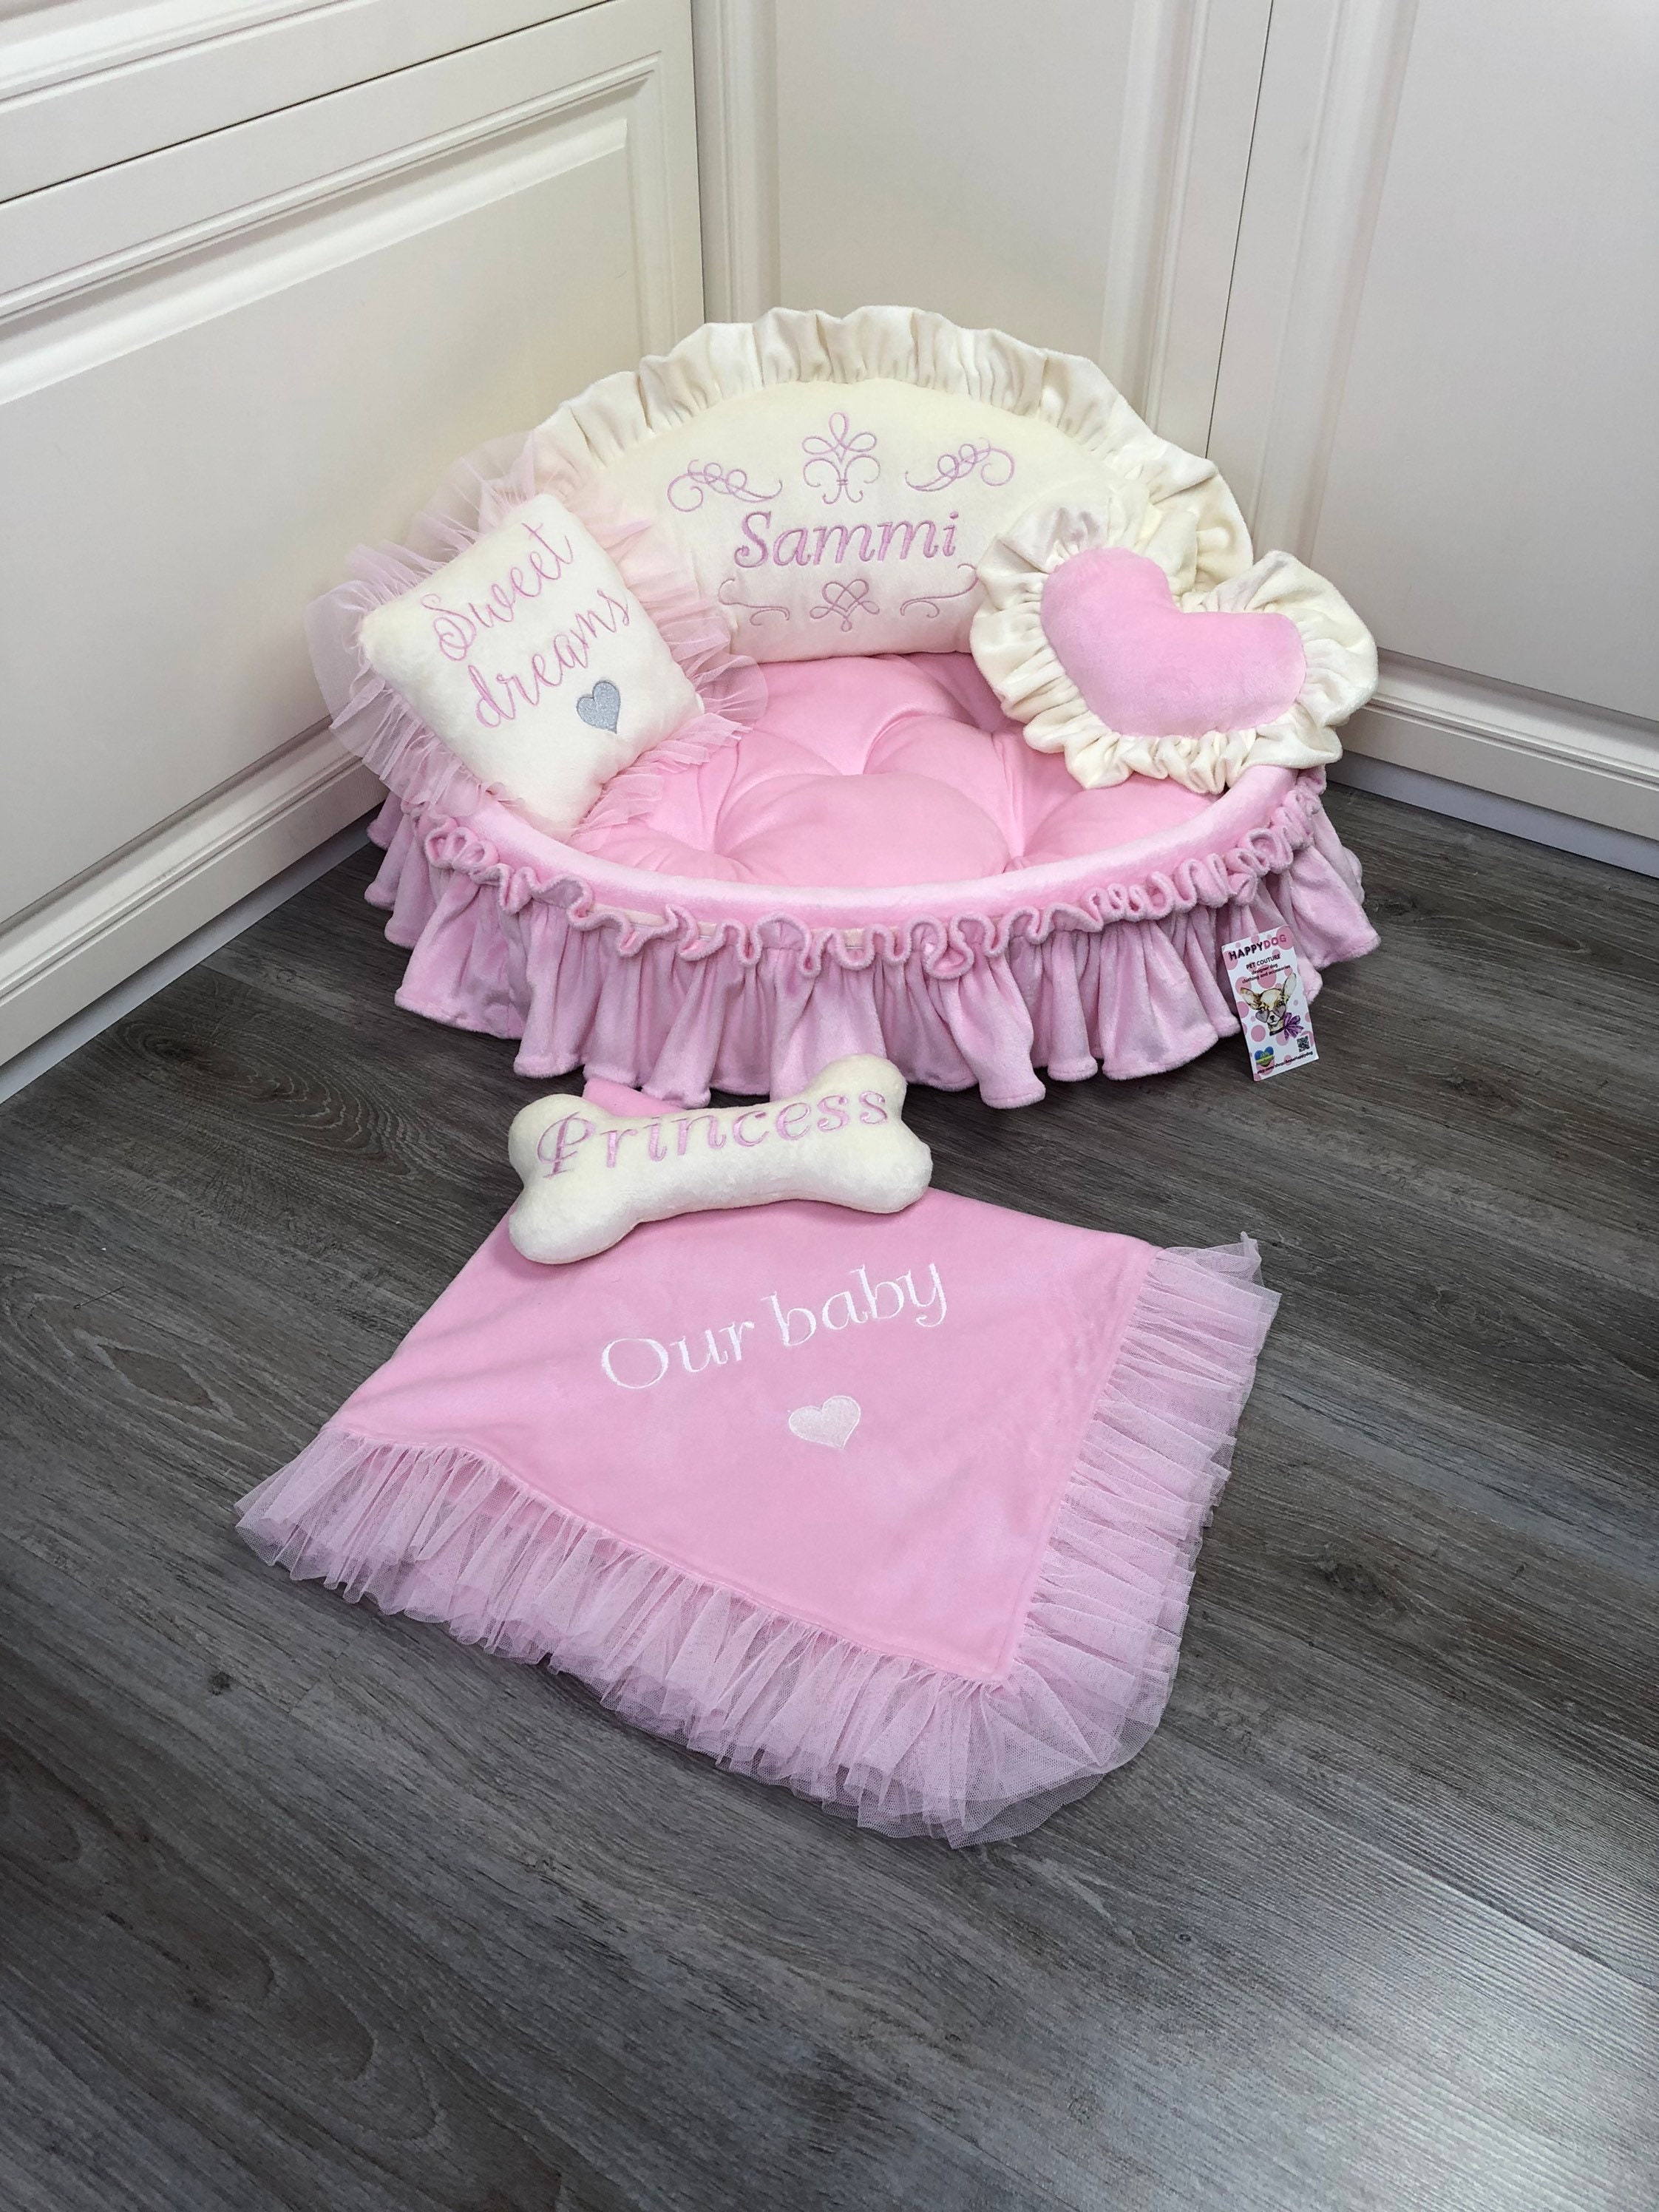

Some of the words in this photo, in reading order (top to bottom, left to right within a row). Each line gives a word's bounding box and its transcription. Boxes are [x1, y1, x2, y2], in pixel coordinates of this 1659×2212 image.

[734, 511, 959, 568] Sammi
[421, 523, 573, 662] Sweet
[468, 588, 630, 728] dreams
[1228, 934, 1286, 961] HAPPYDOG
[1242, 975, 1260, 984] clothing
[1269, 965, 1291, 975] accessories
[1246, 962, 1256, 970] PET
[1257, 953, 1280, 966] COUTURE
[1251, 966, 1269, 975] designer
[537, 1090, 889, 1178] Princess
[601, 1320, 754, 1389] Our
[760, 1263, 947, 1347] baby
